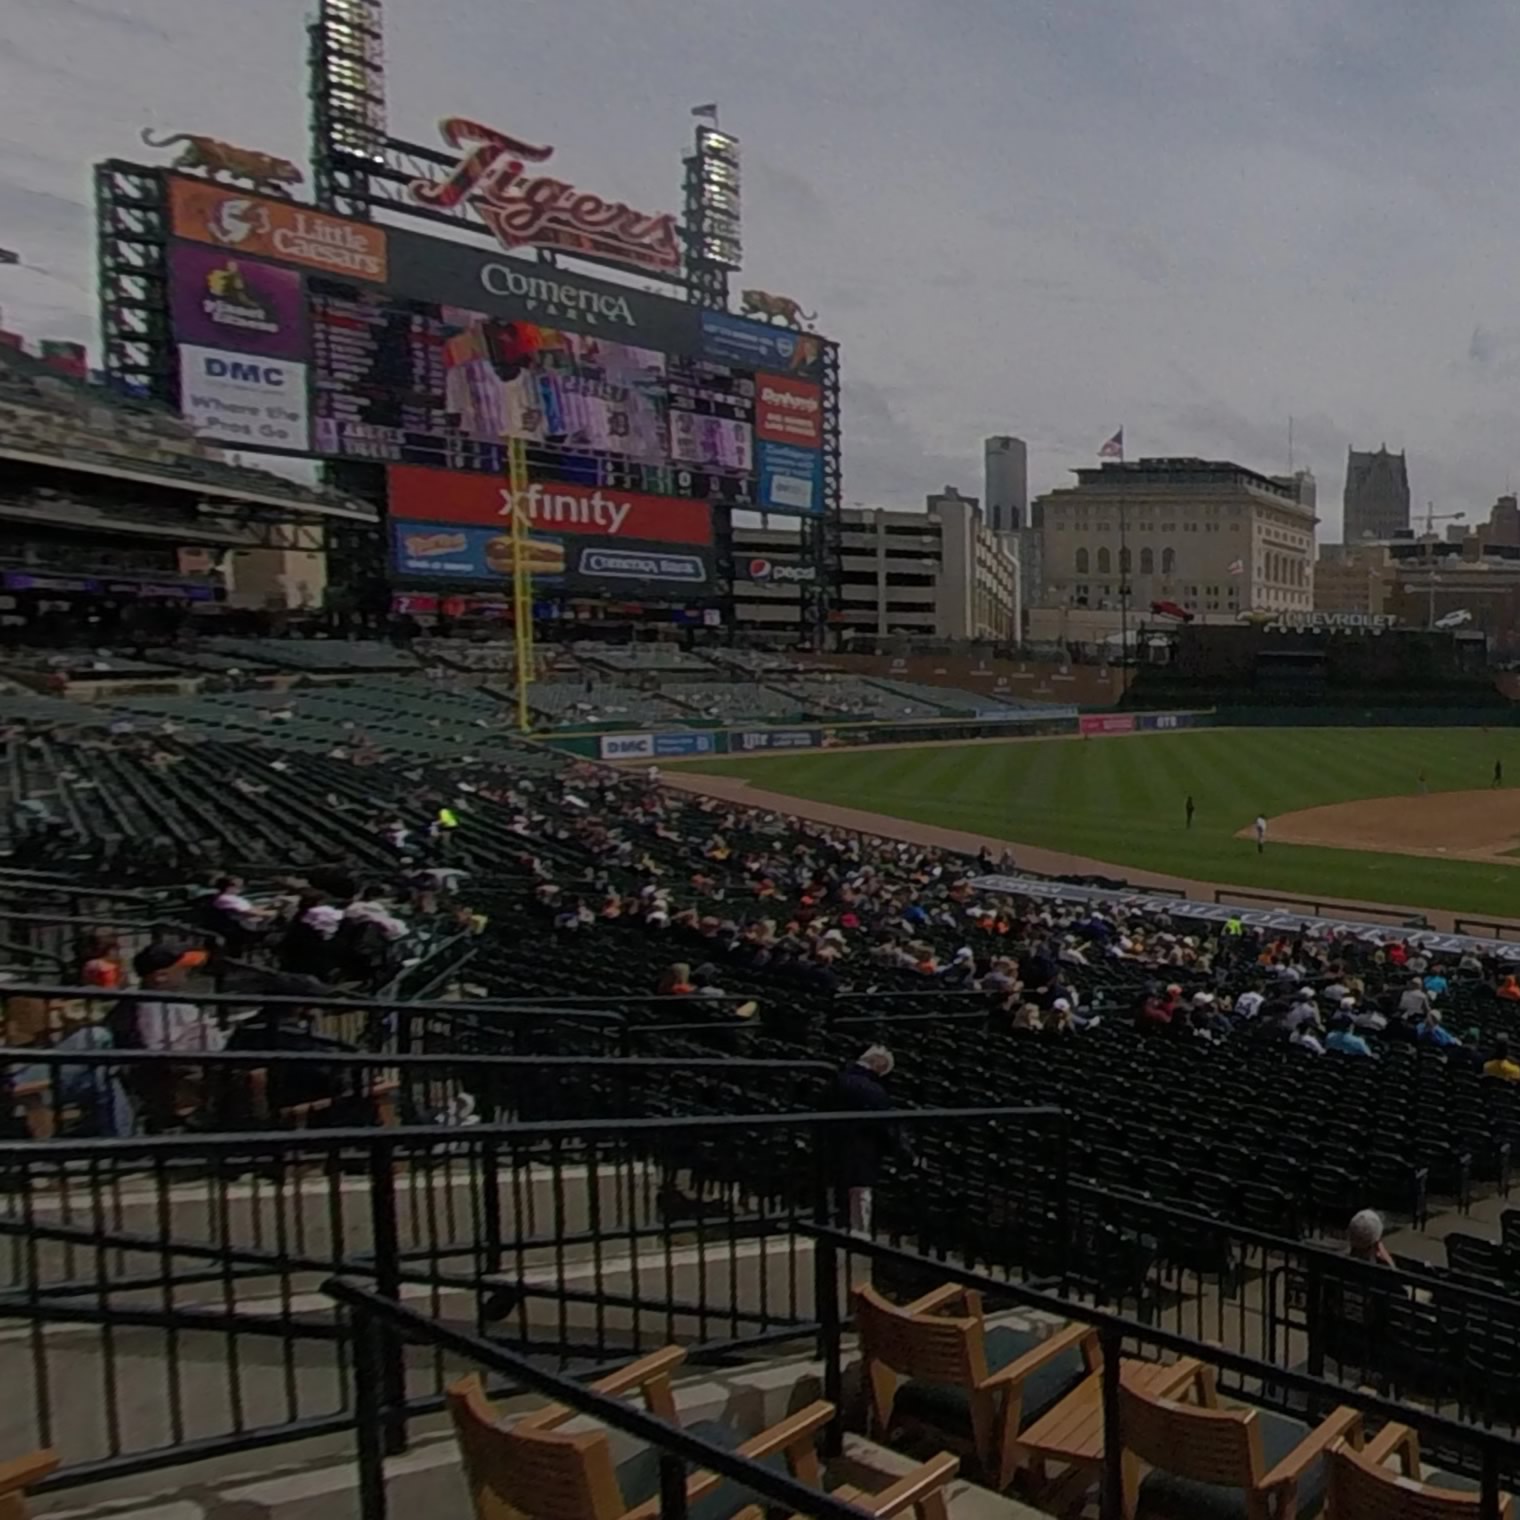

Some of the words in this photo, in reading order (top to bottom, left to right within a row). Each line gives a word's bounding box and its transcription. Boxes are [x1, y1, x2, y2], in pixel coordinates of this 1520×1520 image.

[408, 117, 682, 266] Tigers
[272, 227, 383, 274] Caesars
[292, 212, 370, 252] Little
[204, 357, 284, 386] DMC
[498, 483, 631, 533] xfinity
[607, 741, 648, 754] DMC
